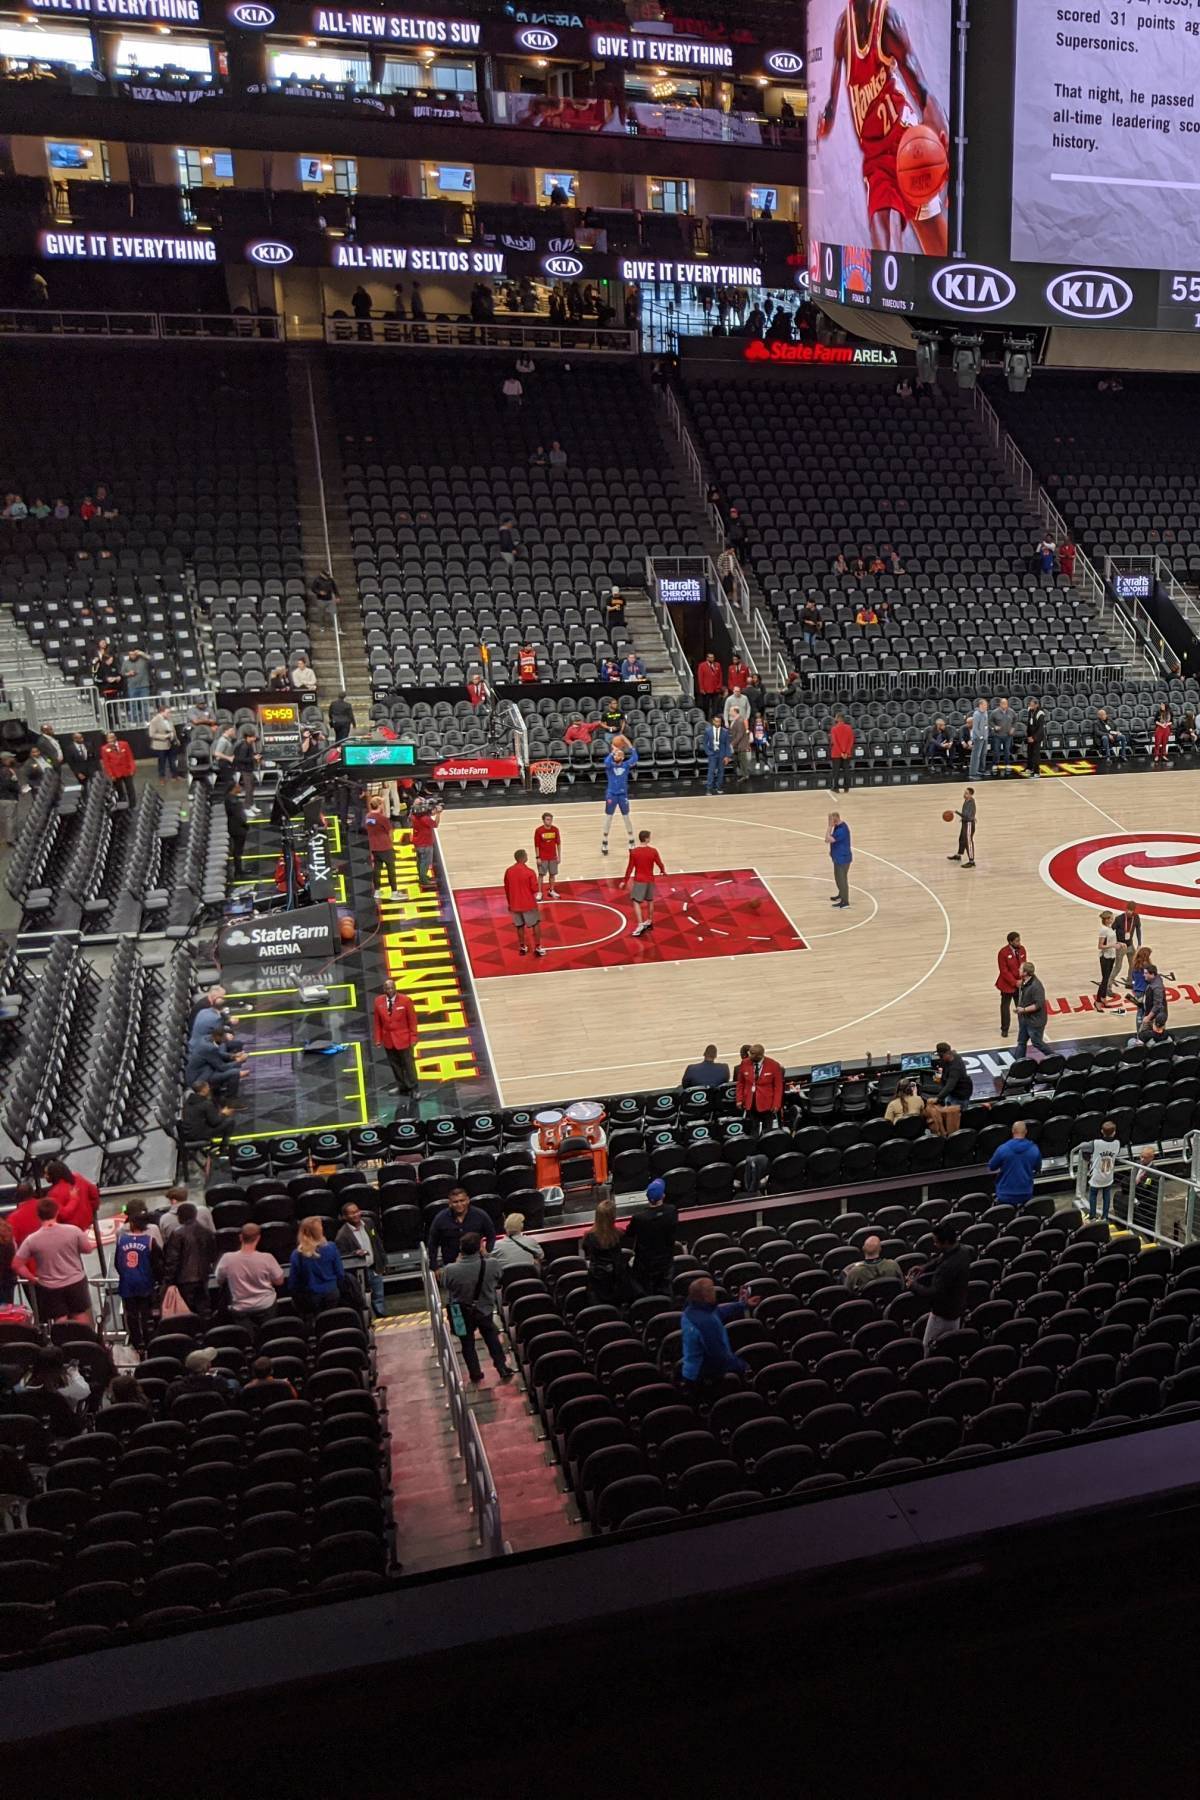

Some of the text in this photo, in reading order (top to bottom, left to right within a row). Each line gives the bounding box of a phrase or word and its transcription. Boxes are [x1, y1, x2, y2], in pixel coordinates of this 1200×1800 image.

[318, 11, 481, 45] ALL-NEW SELTOS SUV
[1056, 9, 1101, 25] scored
[1110, 11, 1126, 27] 31
[1137, 14, 1176, 31] points
[596, 36, 733, 67] GIVE IT EVERYTHING
[1055, 32, 1139, 53] Supersonics.
[850, 67, 887, 137] Hawks
[1054, 82, 1082, 99] That
[1087, 85, 1124, 105] night,
[1129, 89, 1145, 104] he
[1150, 91, 1194, 109] passed
[876, 94, 900, 136] 21
[1053, 109, 1103, 126] all-time
[1111, 113, 1171, 133] leadering
[1052, 133, 1100, 152] history.
[46, 234, 217, 261] GIVE IT EVERYTHING
[338, 247, 505, 273] ALL-NEW SELTOS SUV
[622, 261, 762, 286] GIVE IT EVERYTHING
[825, 247, 833, 282] 0
[884, 254, 899, 291] 0
[881, 298, 907, 310] TIMEOUTS
[308, 830, 331, 880] xfinity
[259, 942, 302, 957] ARENA
[383, 927, 480, 1082] ATLANTA
